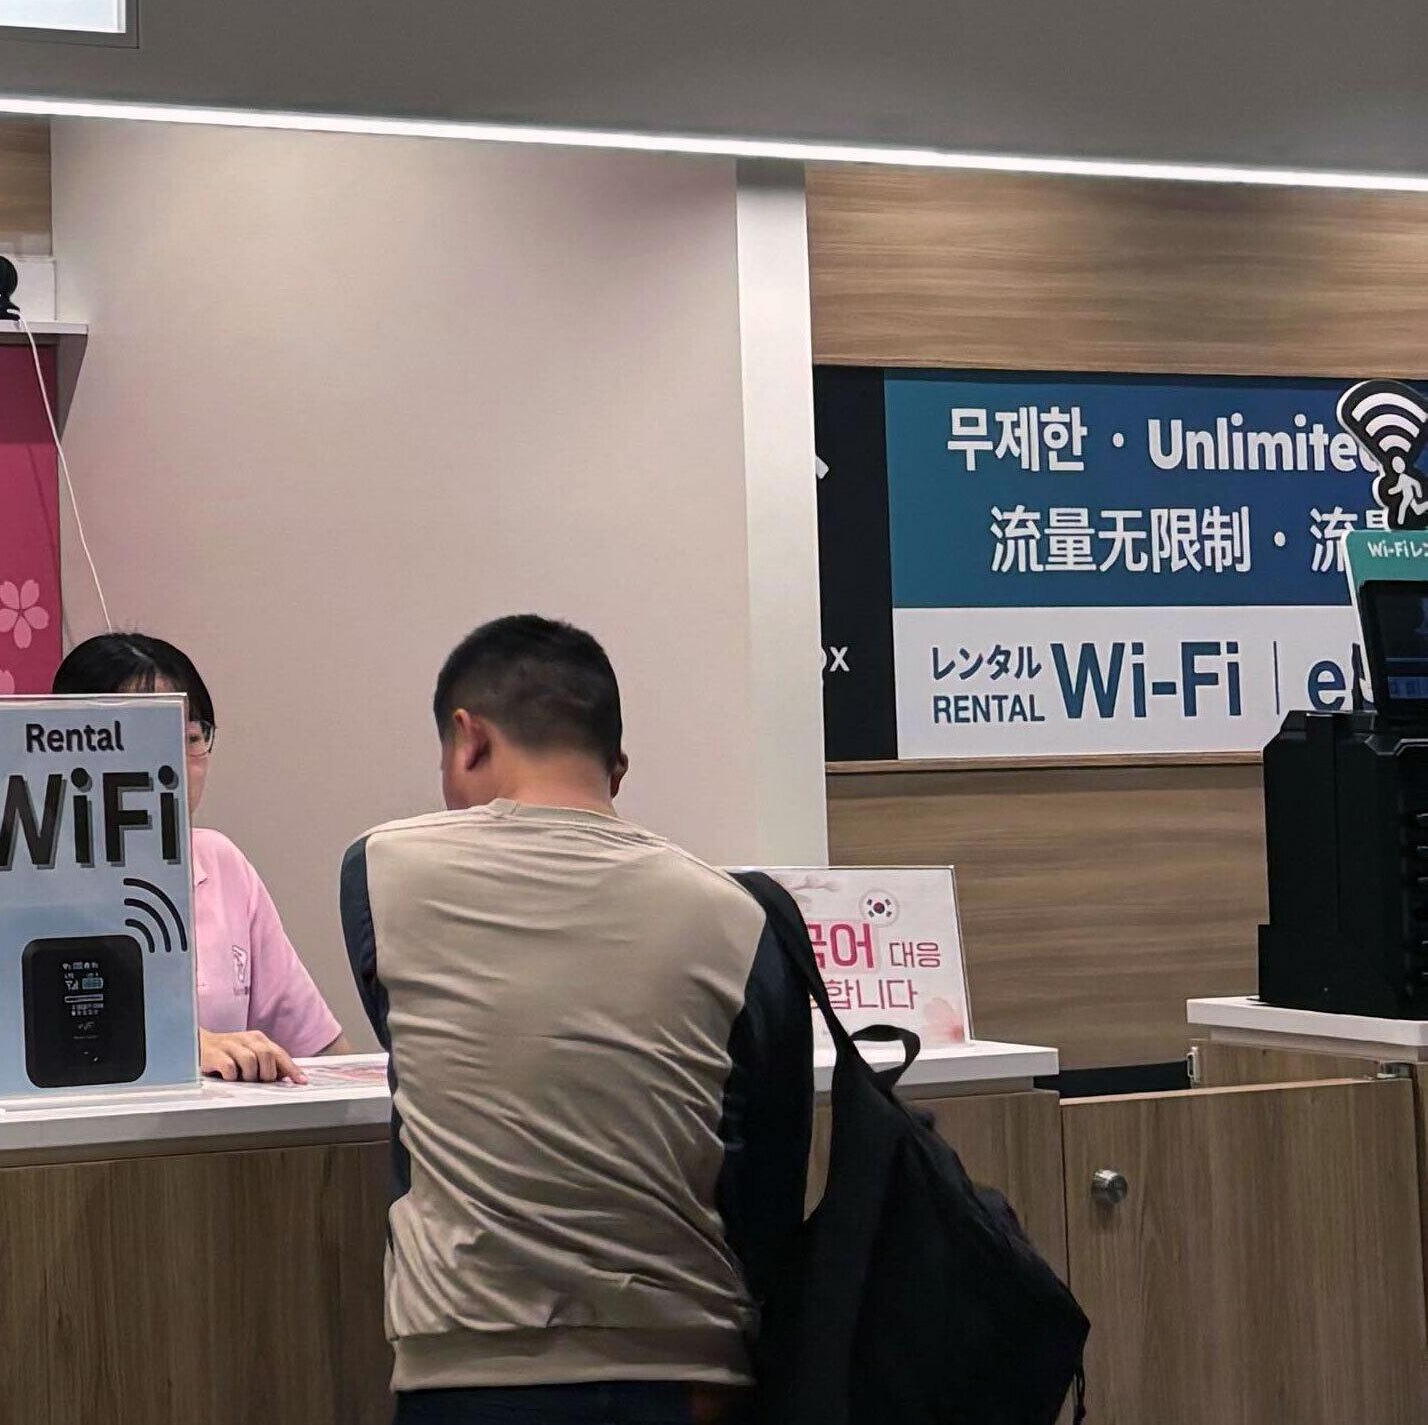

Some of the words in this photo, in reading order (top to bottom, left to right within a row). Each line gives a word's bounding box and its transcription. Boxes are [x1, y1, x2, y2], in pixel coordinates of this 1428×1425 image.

[947, 405, 1086, 475] 무제한
[989, 505, 1251, 575] 流量无限制
[931, 643, 1042, 682] レンタル
[1050, 640, 1242, 719] Wi-Fi
[932, 694, 1046, 725] RENTAL
[25, 720, 125, 754] Rental
[889, 940, 941, 969] 대응
[812, 978, 918, 1010] 합니다
